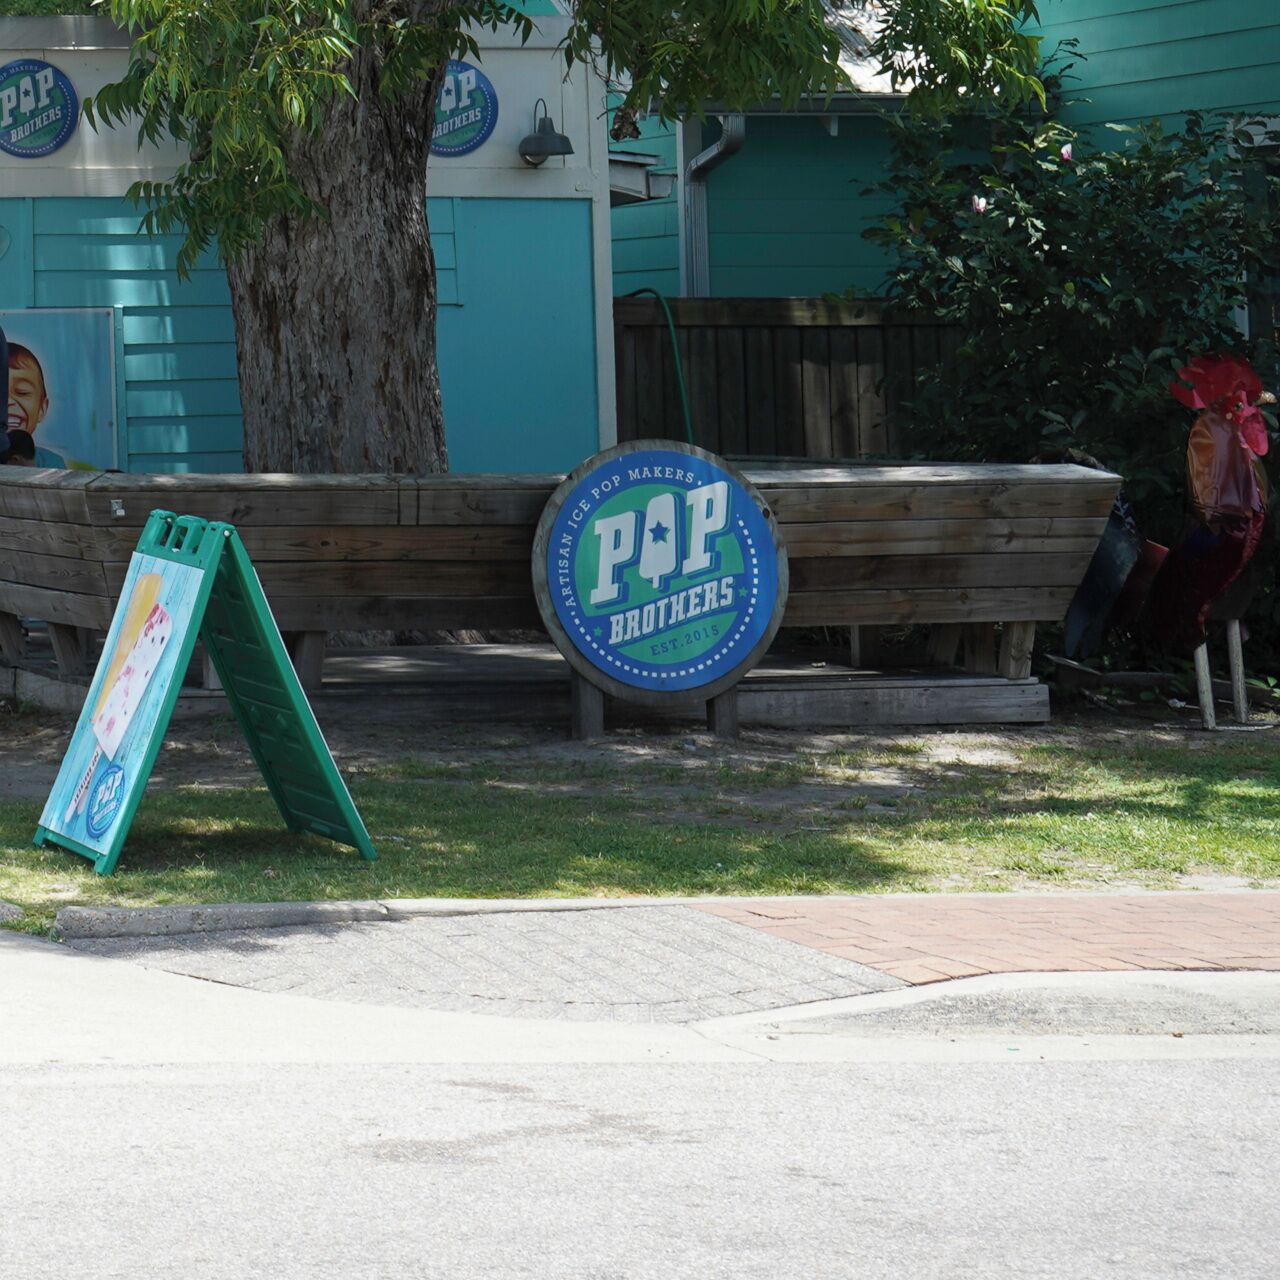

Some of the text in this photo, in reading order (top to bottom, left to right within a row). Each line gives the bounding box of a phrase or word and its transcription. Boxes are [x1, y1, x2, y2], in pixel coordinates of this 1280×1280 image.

[10, 105, 62, 143] BROTHERS
[558, 532, 578, 608] ARTISAN
[568, 498, 591, 529] ICE
[590, 474, 622, 500] POP
[589, 480, 731, 606] POP
[608, 575, 735, 646] BROTHERS
